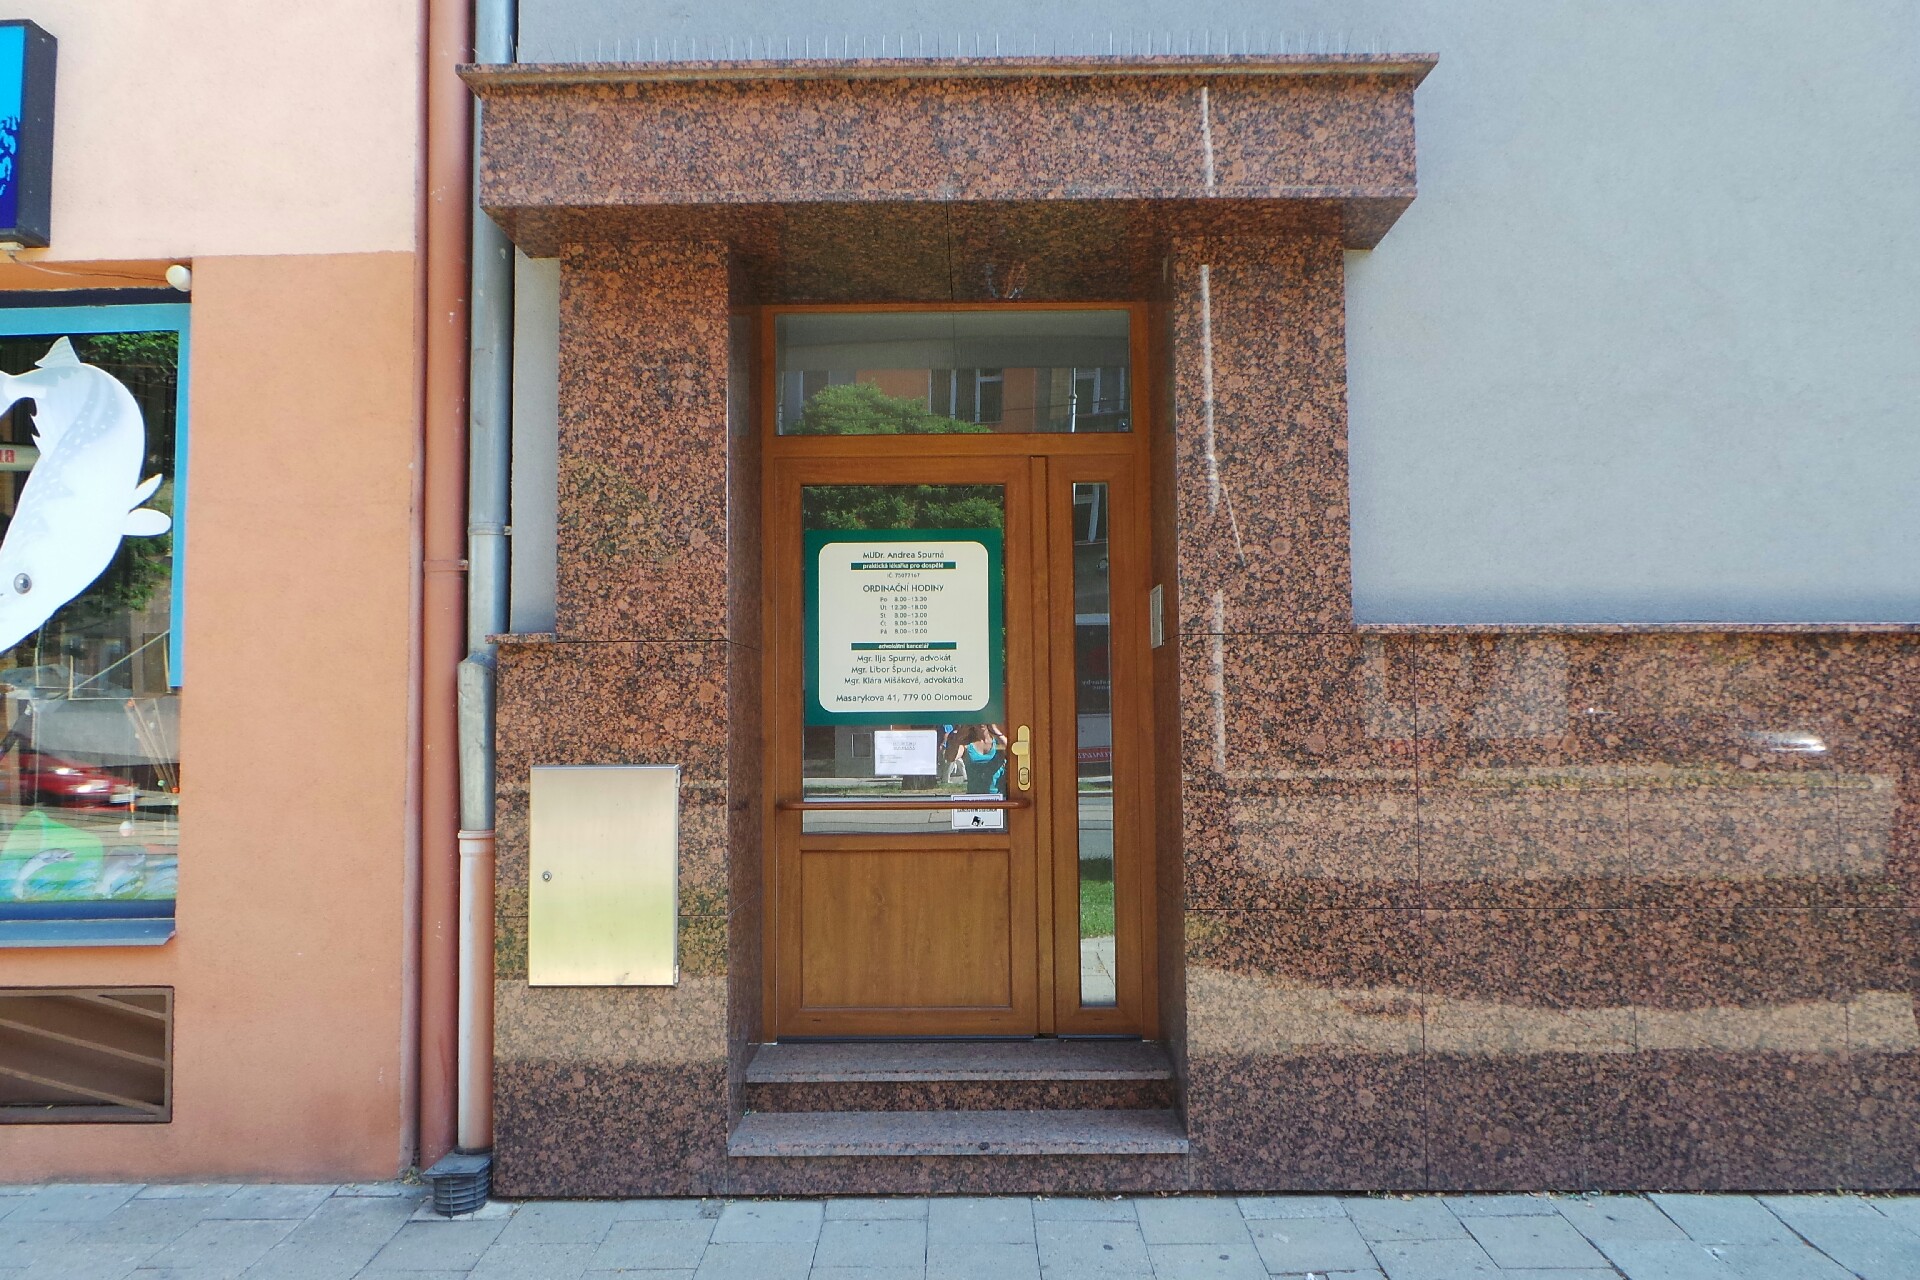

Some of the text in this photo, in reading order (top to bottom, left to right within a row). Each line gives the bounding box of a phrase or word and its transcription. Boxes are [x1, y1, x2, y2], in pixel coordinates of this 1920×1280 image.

[863, 583, 944, 592] ORDINAČNÍ HODINY
[875, 655, 886, 663] Ilja
[889, 654, 917, 663] Spurný,
[892, 664, 923, 673] Špunda,
[844, 677, 860, 685] Mgr.
[884, 677, 921, 685] Mišáková,
[924, 676, 964, 684] advokátka
[836, 694, 884, 703] Masarykova
[887, 694, 900, 702] 41,
